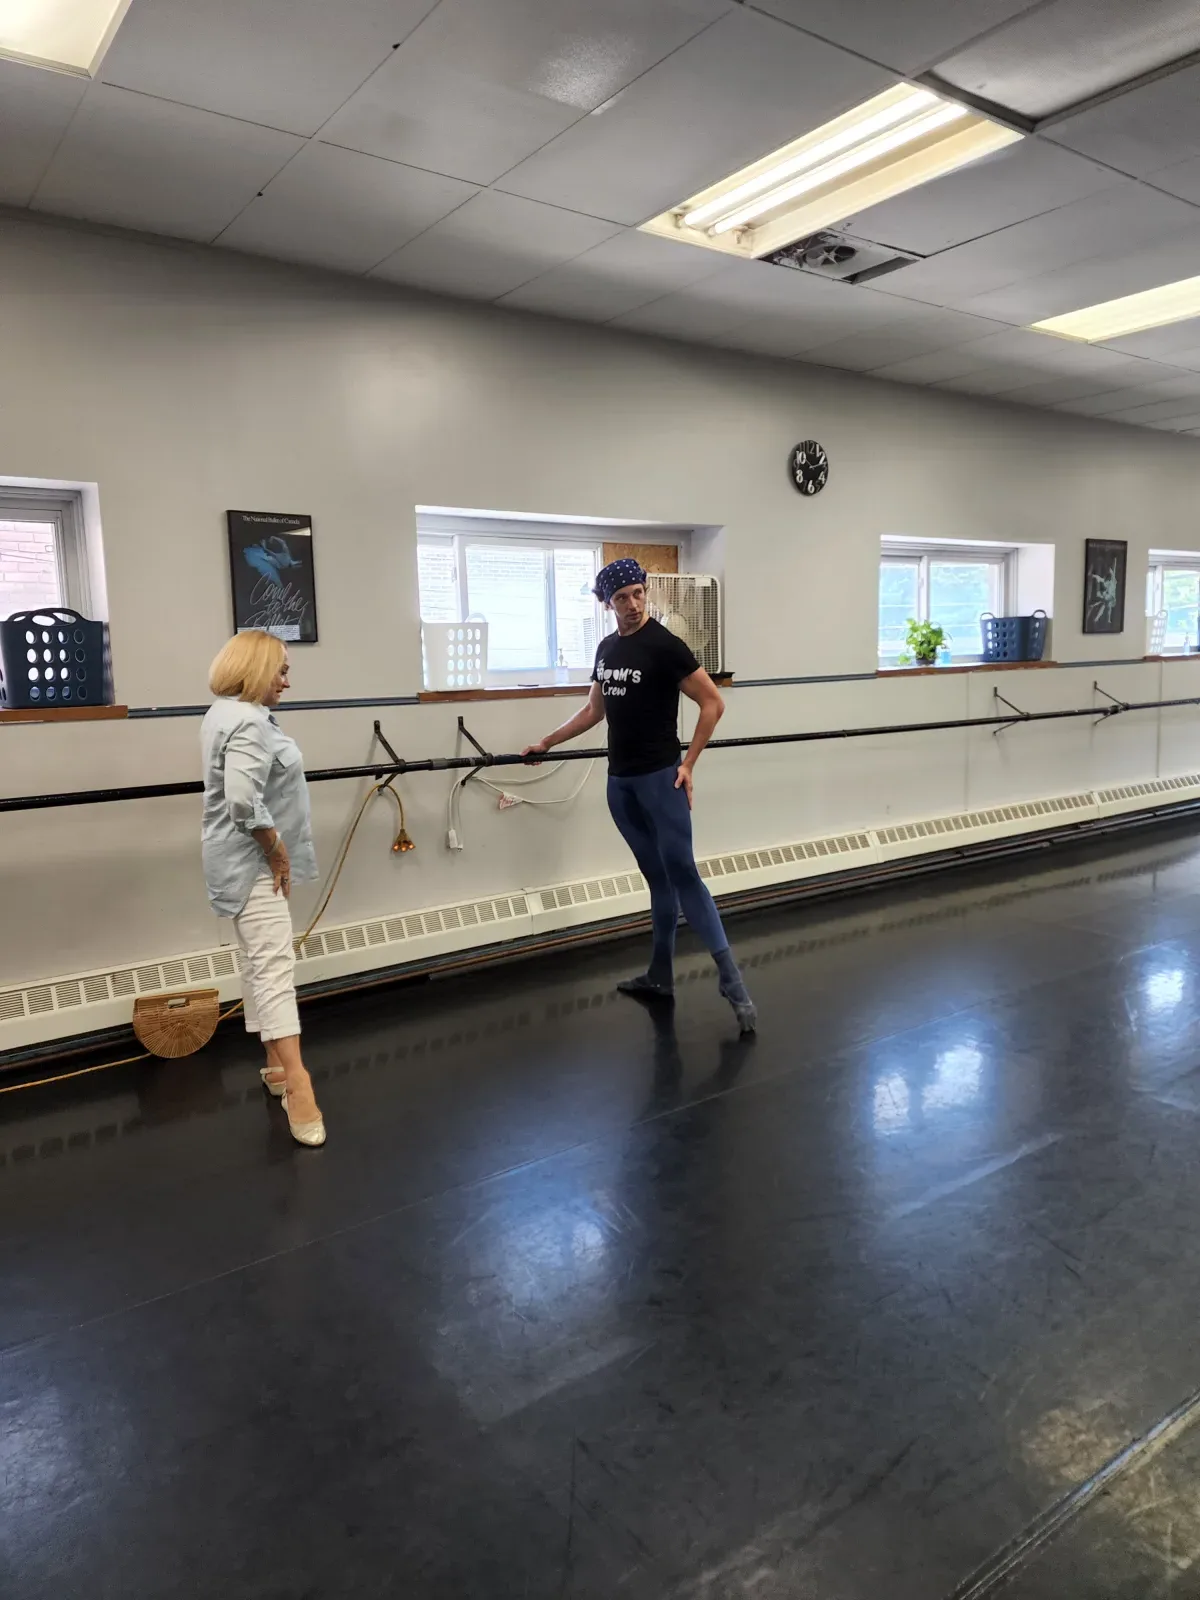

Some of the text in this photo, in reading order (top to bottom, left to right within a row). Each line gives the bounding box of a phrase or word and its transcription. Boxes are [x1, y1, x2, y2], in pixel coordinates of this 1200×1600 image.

[796, 450, 806, 465] 10
[816, 443, 820, 458] 1
[819, 451, 825, 464] 2
[796, 469, 803, 484] 8
[818, 471, 826, 485] 4
[807, 480, 815, 494] 6
[284, 517, 300, 525] Canada
[602, 679, 627, 697] Crew
